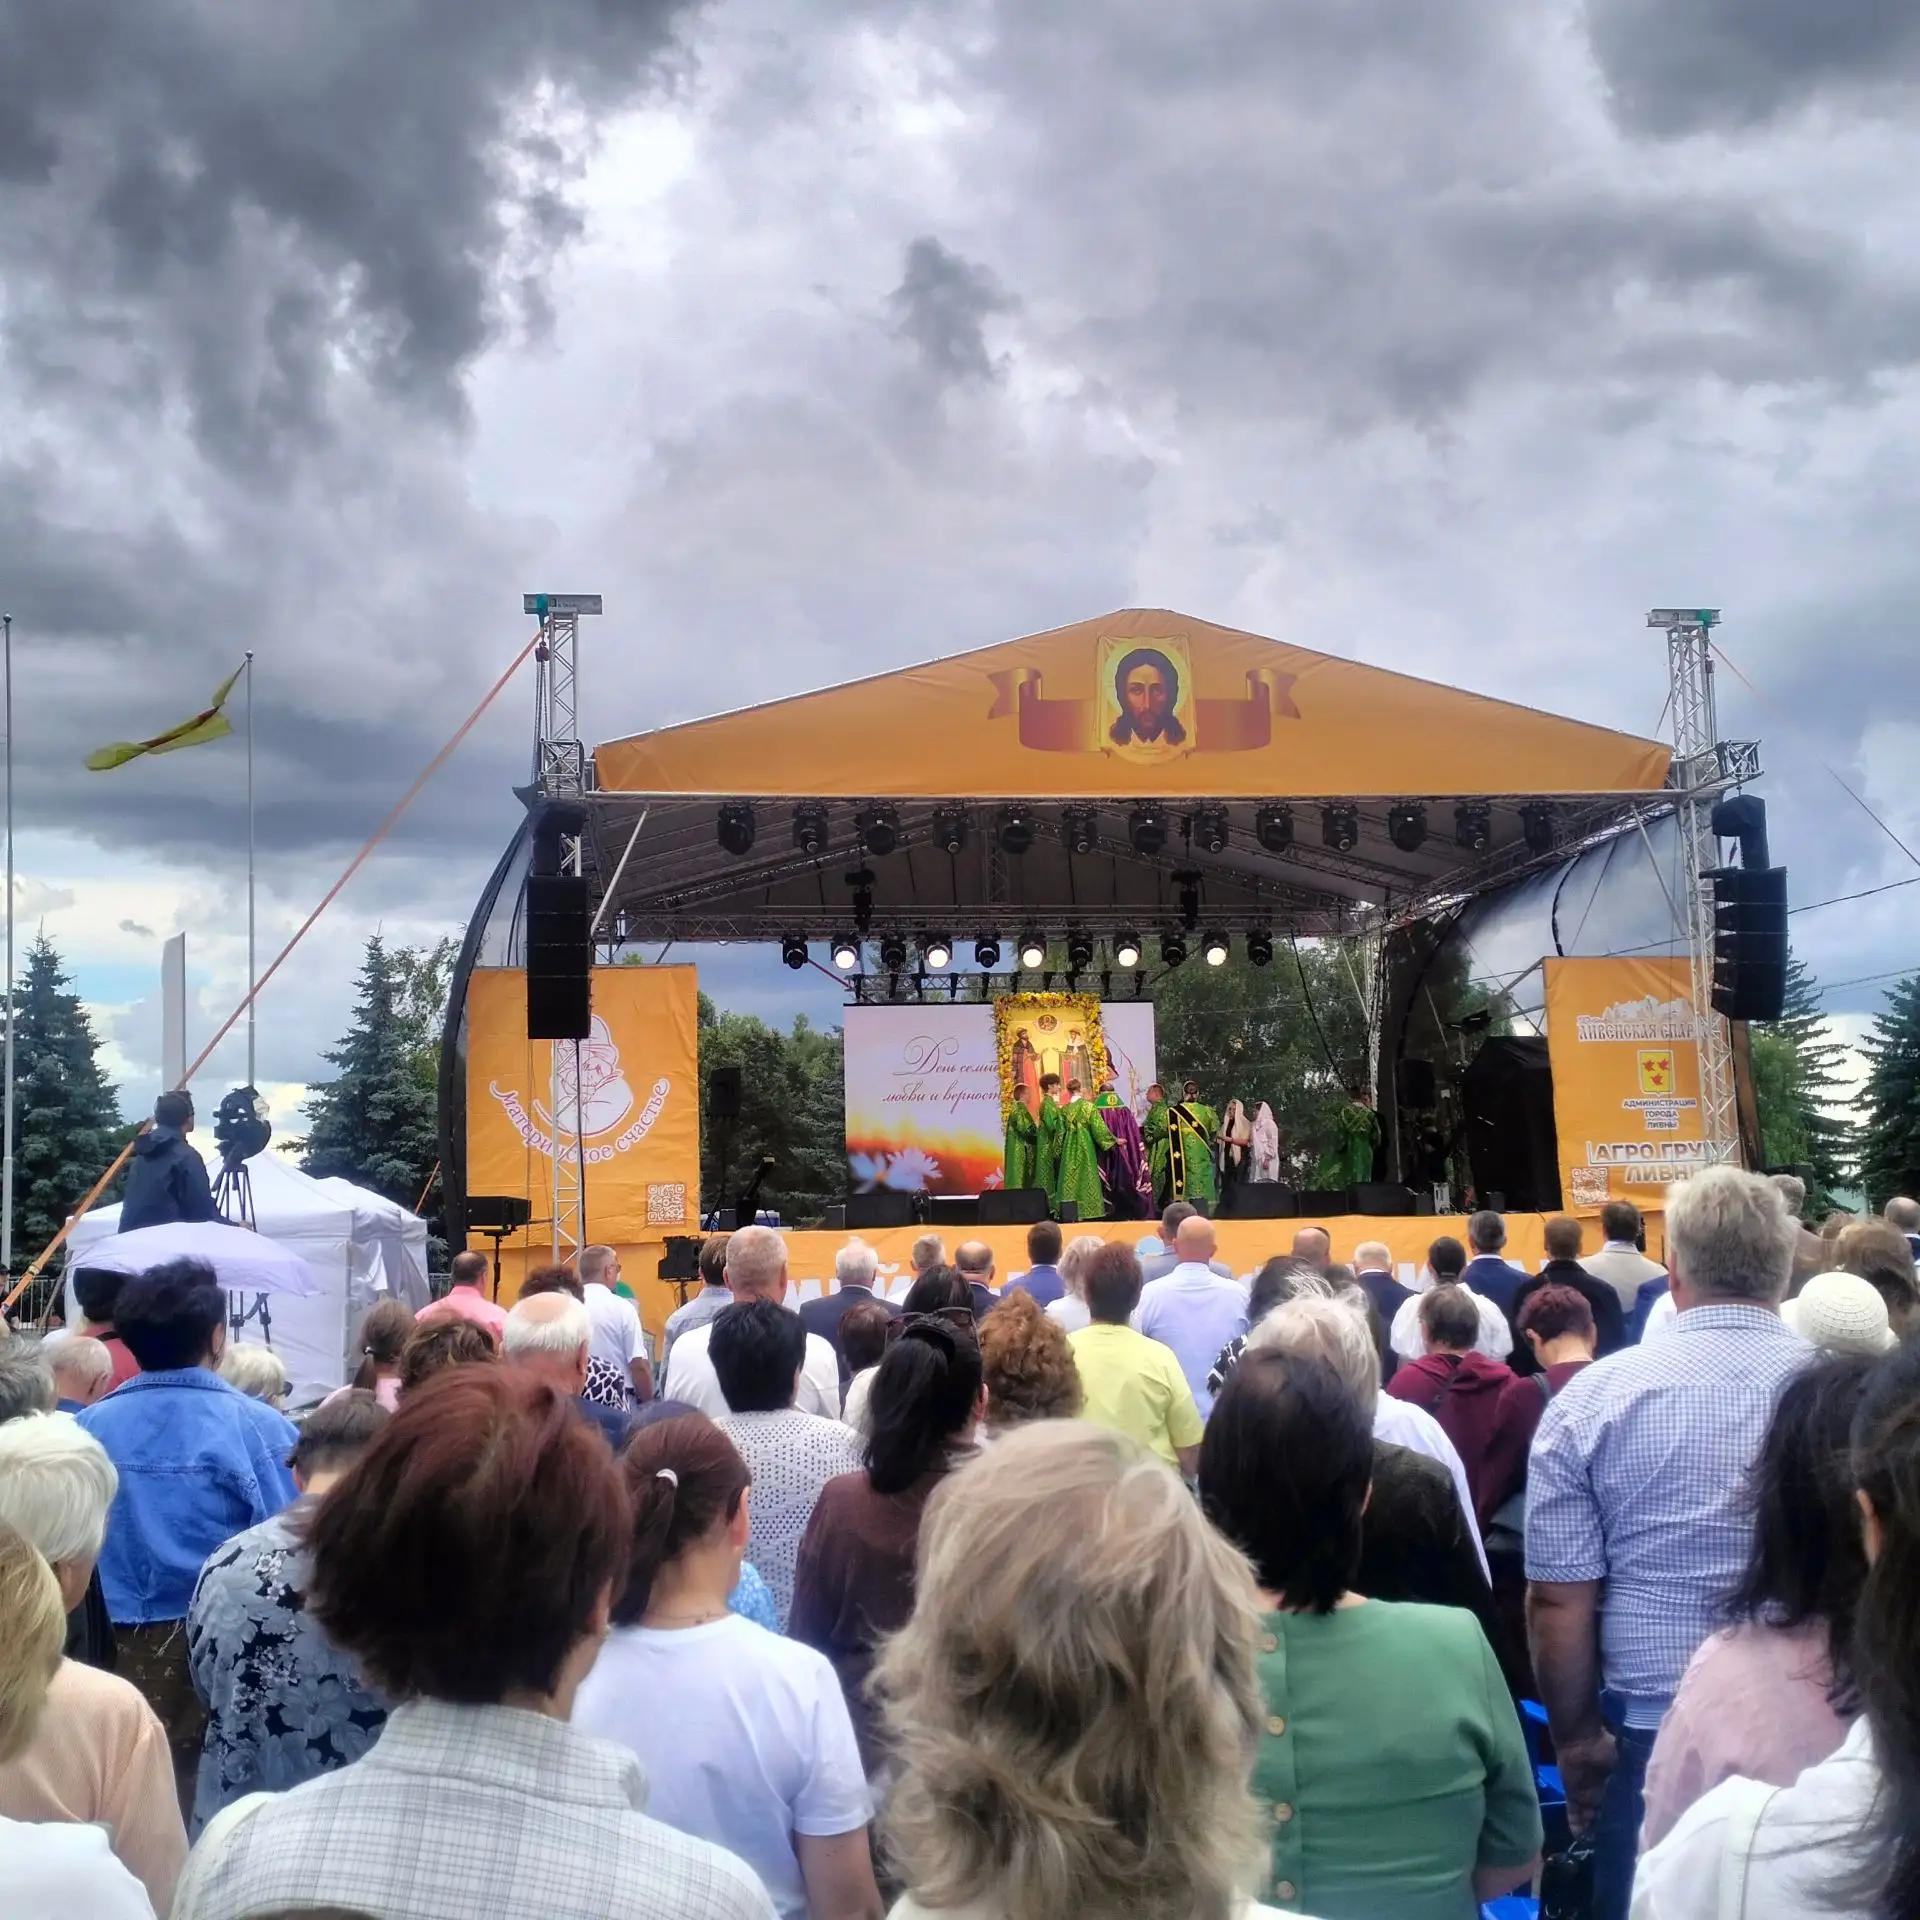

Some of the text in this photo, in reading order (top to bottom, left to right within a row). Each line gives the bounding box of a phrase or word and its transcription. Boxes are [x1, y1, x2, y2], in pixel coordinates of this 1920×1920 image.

[892, 1035, 959, 1076] День
[882, 1080, 1000, 1114] любви и верност
[1623, 1099, 1696, 1108] АДМИНИСТРАЦИЯ
[616, 1080, 669, 1151] счастье
[1645, 1110, 1678, 1118] ГОРОДА
[1647, 1121, 1678, 1129] ЛИВНЫ
[1596, 1143, 1654, 1160] АГРО
